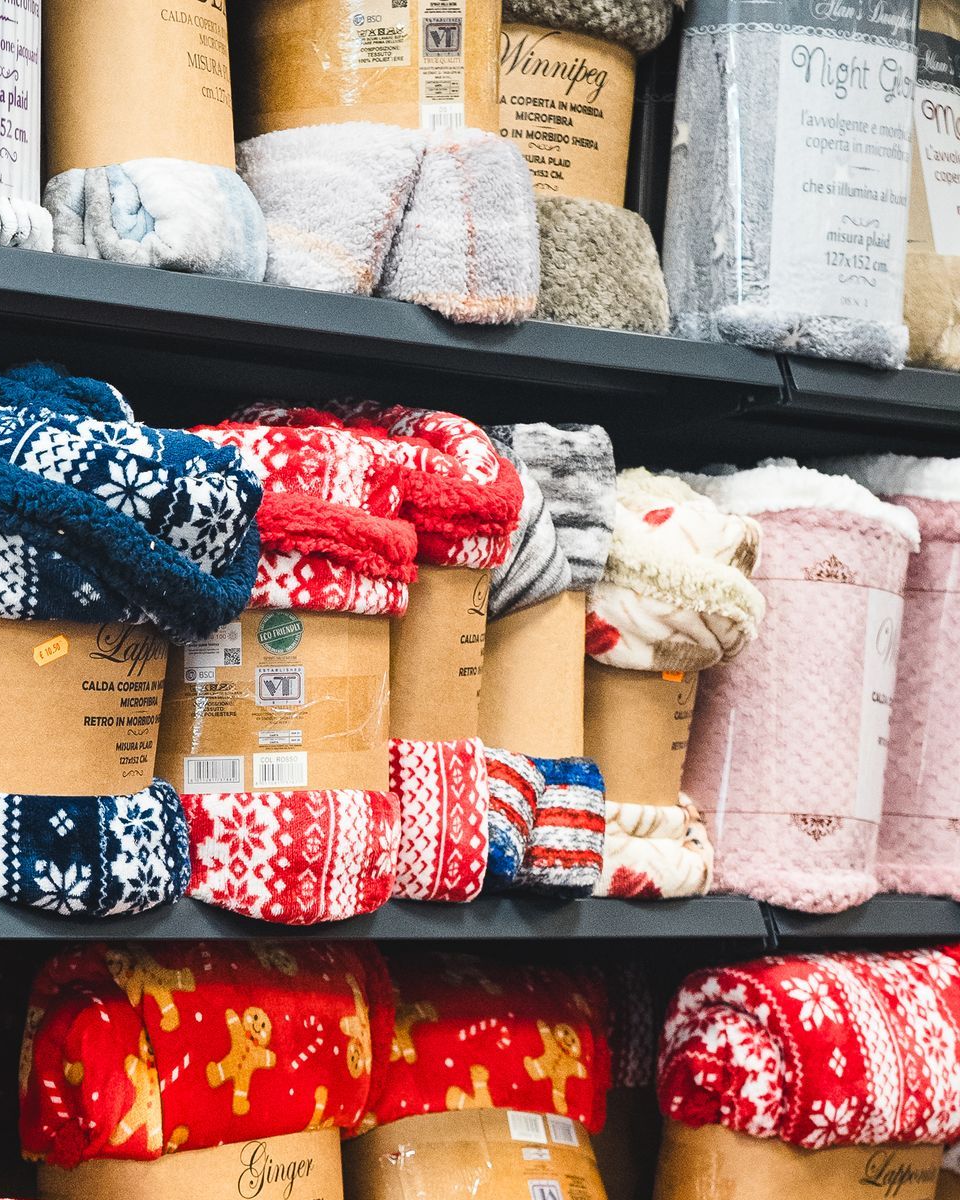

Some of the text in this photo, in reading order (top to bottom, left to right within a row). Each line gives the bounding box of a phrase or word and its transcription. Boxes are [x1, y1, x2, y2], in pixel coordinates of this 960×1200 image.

[160, 9, 193, 25] CALDA
[500, 31, 608, 104] Winnipeg
[792, 45, 869, 99] Night
[8, 85, 29, 112] plaid
[510, 95, 604, 119] COPERTA IN MORBIDA
[515, 111, 574, 127] MICROFIBRA
[801, 109, 868, 136] l'avvolgente
[14, 127, 28, 143] cm.
[512, 129, 599, 150] IN MORBIDO SHERPA
[805, 137, 849, 154] coperta
[548, 156, 571, 168] PLAID
[802, 178, 824, 194] che
[827, 228, 890, 252] misura plaid
[825, 251, 871, 270] 127x152
[259, 622, 301, 641] ECO FRIENDLY
[458, 667, 477, 677] RETRO
[82, 680, 115, 691] CALDA
[117, 680, 150, 691] COPERTA
[120, 696, 158, 707] MICROFIBRA
[83, 716, 114, 726] RETRO
[115, 717, 125, 726] IN
[126, 715, 154, 726] MORBIDO
[116, 741, 138, 751] MISURA
[237, 1140, 314, 1200] Ginger
